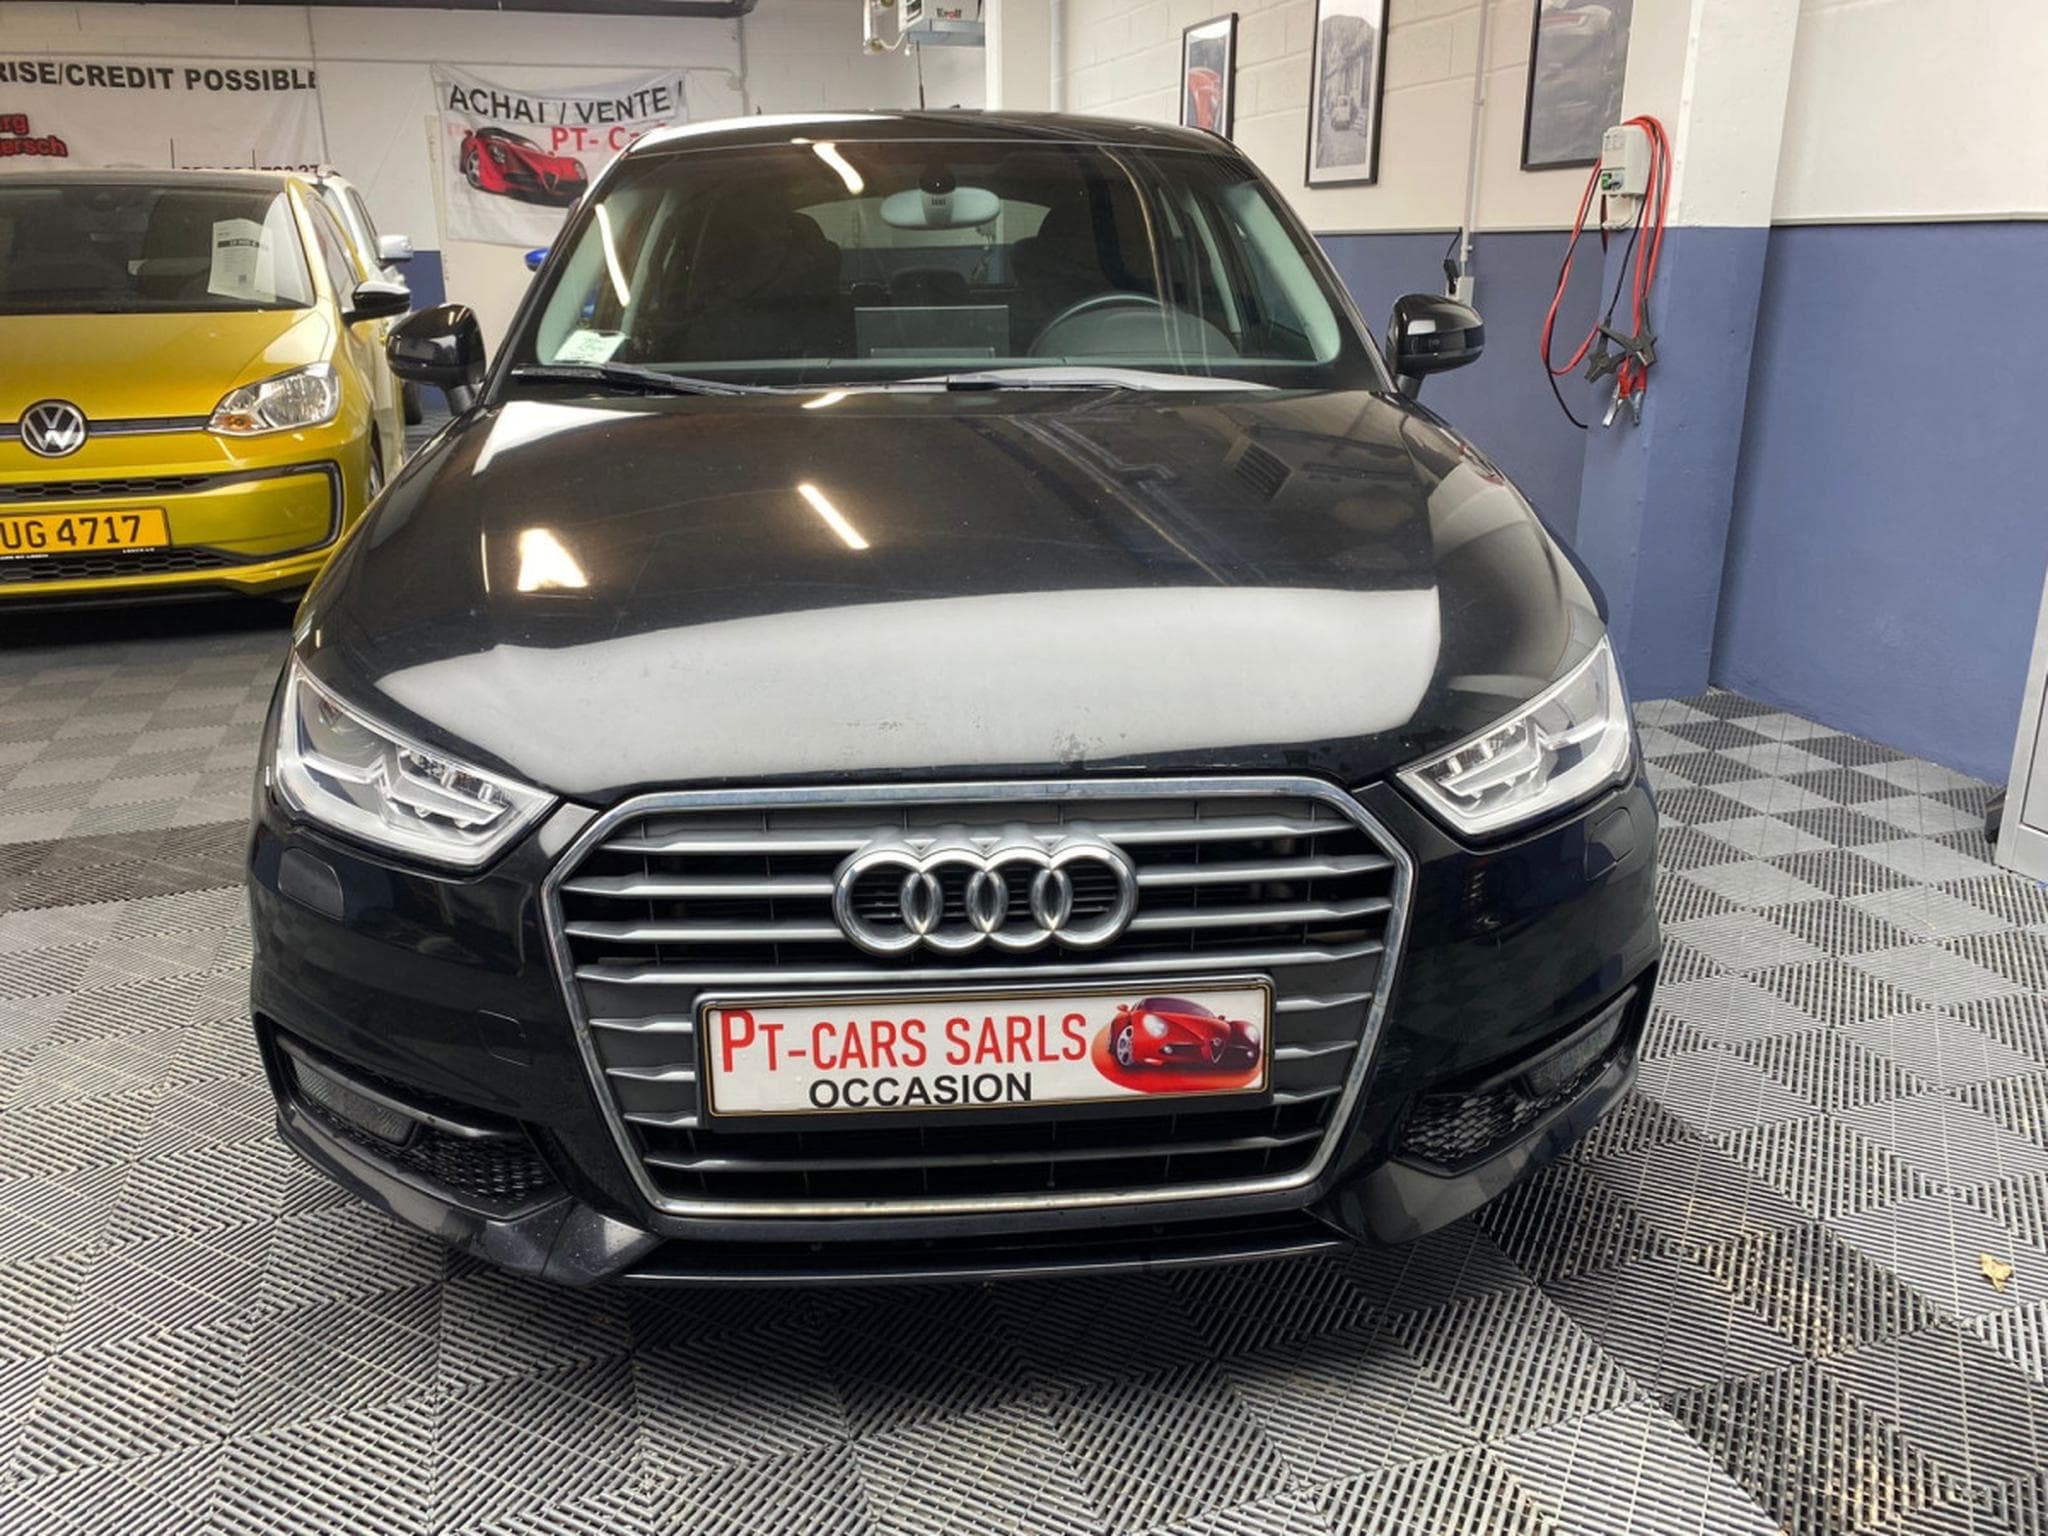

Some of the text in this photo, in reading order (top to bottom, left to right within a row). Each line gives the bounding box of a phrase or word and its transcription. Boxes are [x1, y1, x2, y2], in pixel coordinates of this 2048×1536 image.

[575, 86, 671, 124] VENTE
[0, 514, 141, 550] UG 4717
[944, 1012, 1088, 1066] SARLS
[808, 1072, 1033, 1109] OCCASION
